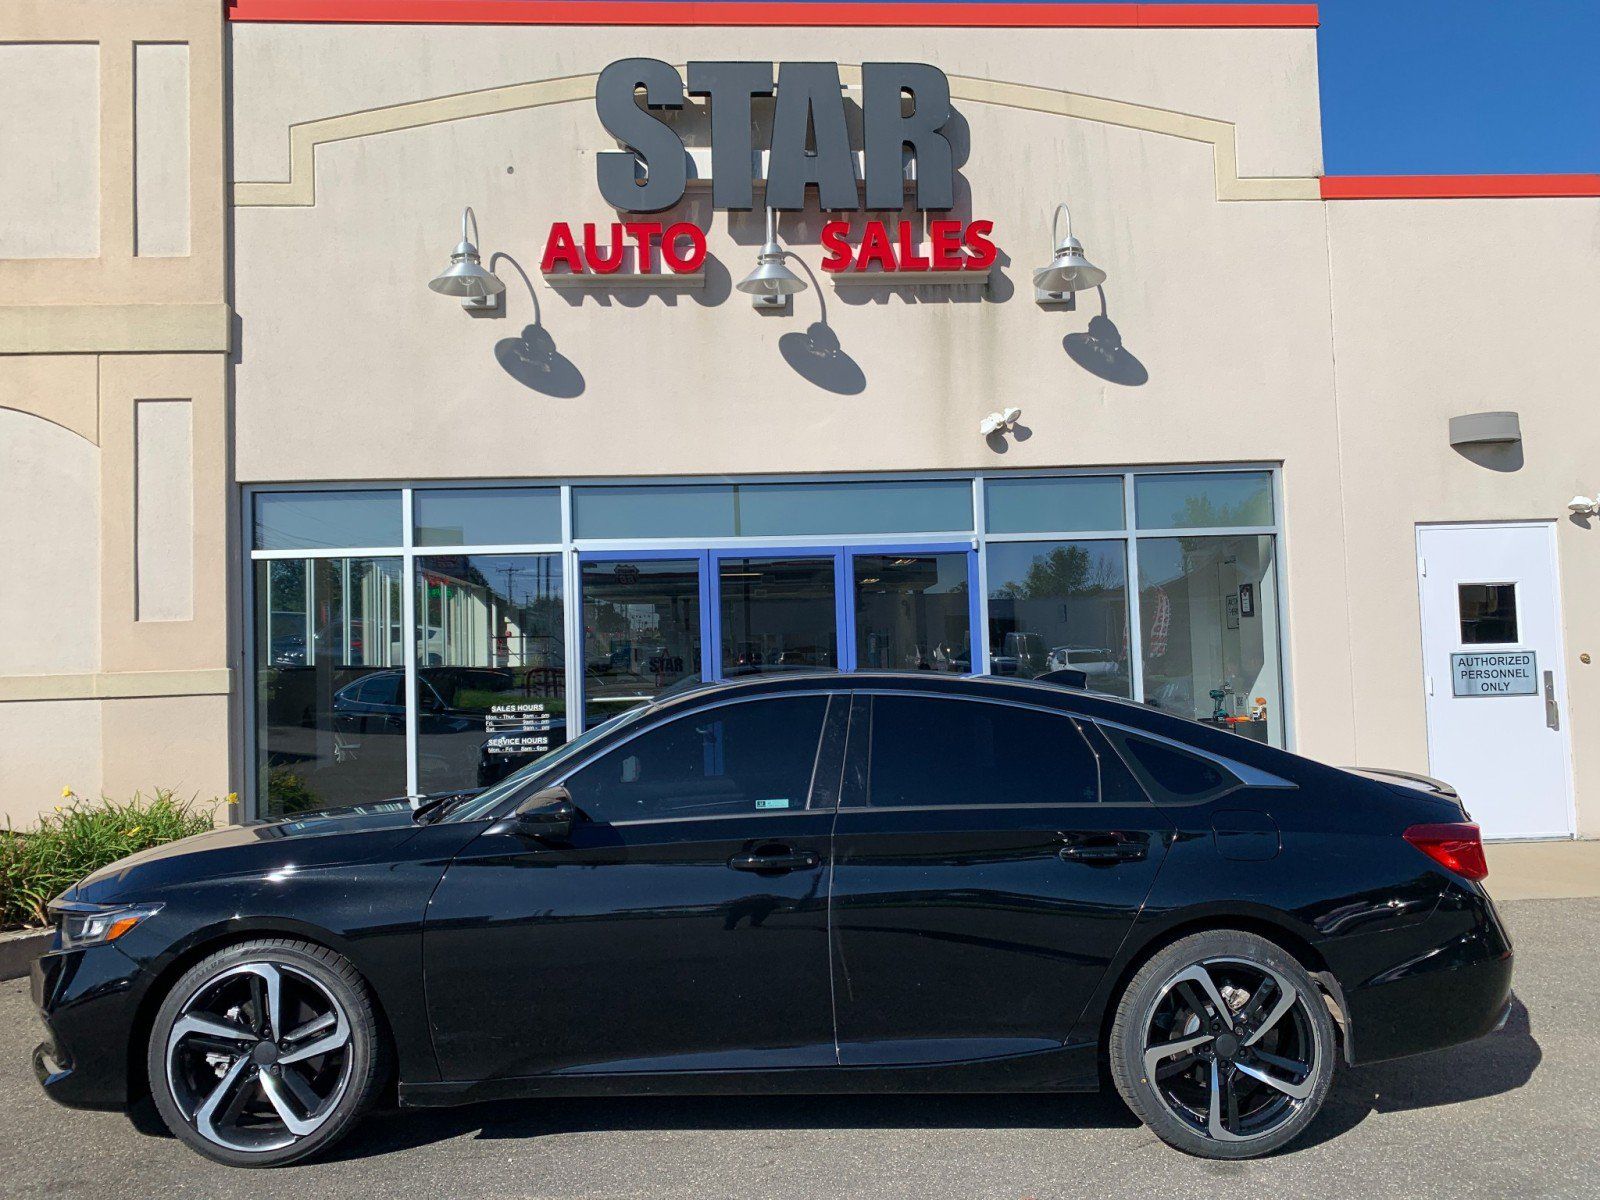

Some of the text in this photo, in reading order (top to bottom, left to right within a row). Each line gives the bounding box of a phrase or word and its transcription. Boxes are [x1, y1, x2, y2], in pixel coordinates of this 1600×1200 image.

[596, 57, 954, 212] STAR
[539, 220, 998, 274] AUTO SALES
[1458, 655, 1530, 667] AUTHORIZED
[1461, 668, 1530, 680] PERSONNEL
[1481, 681, 1511, 692] ONLY
[488, 738, 520, 746] SERVICE
